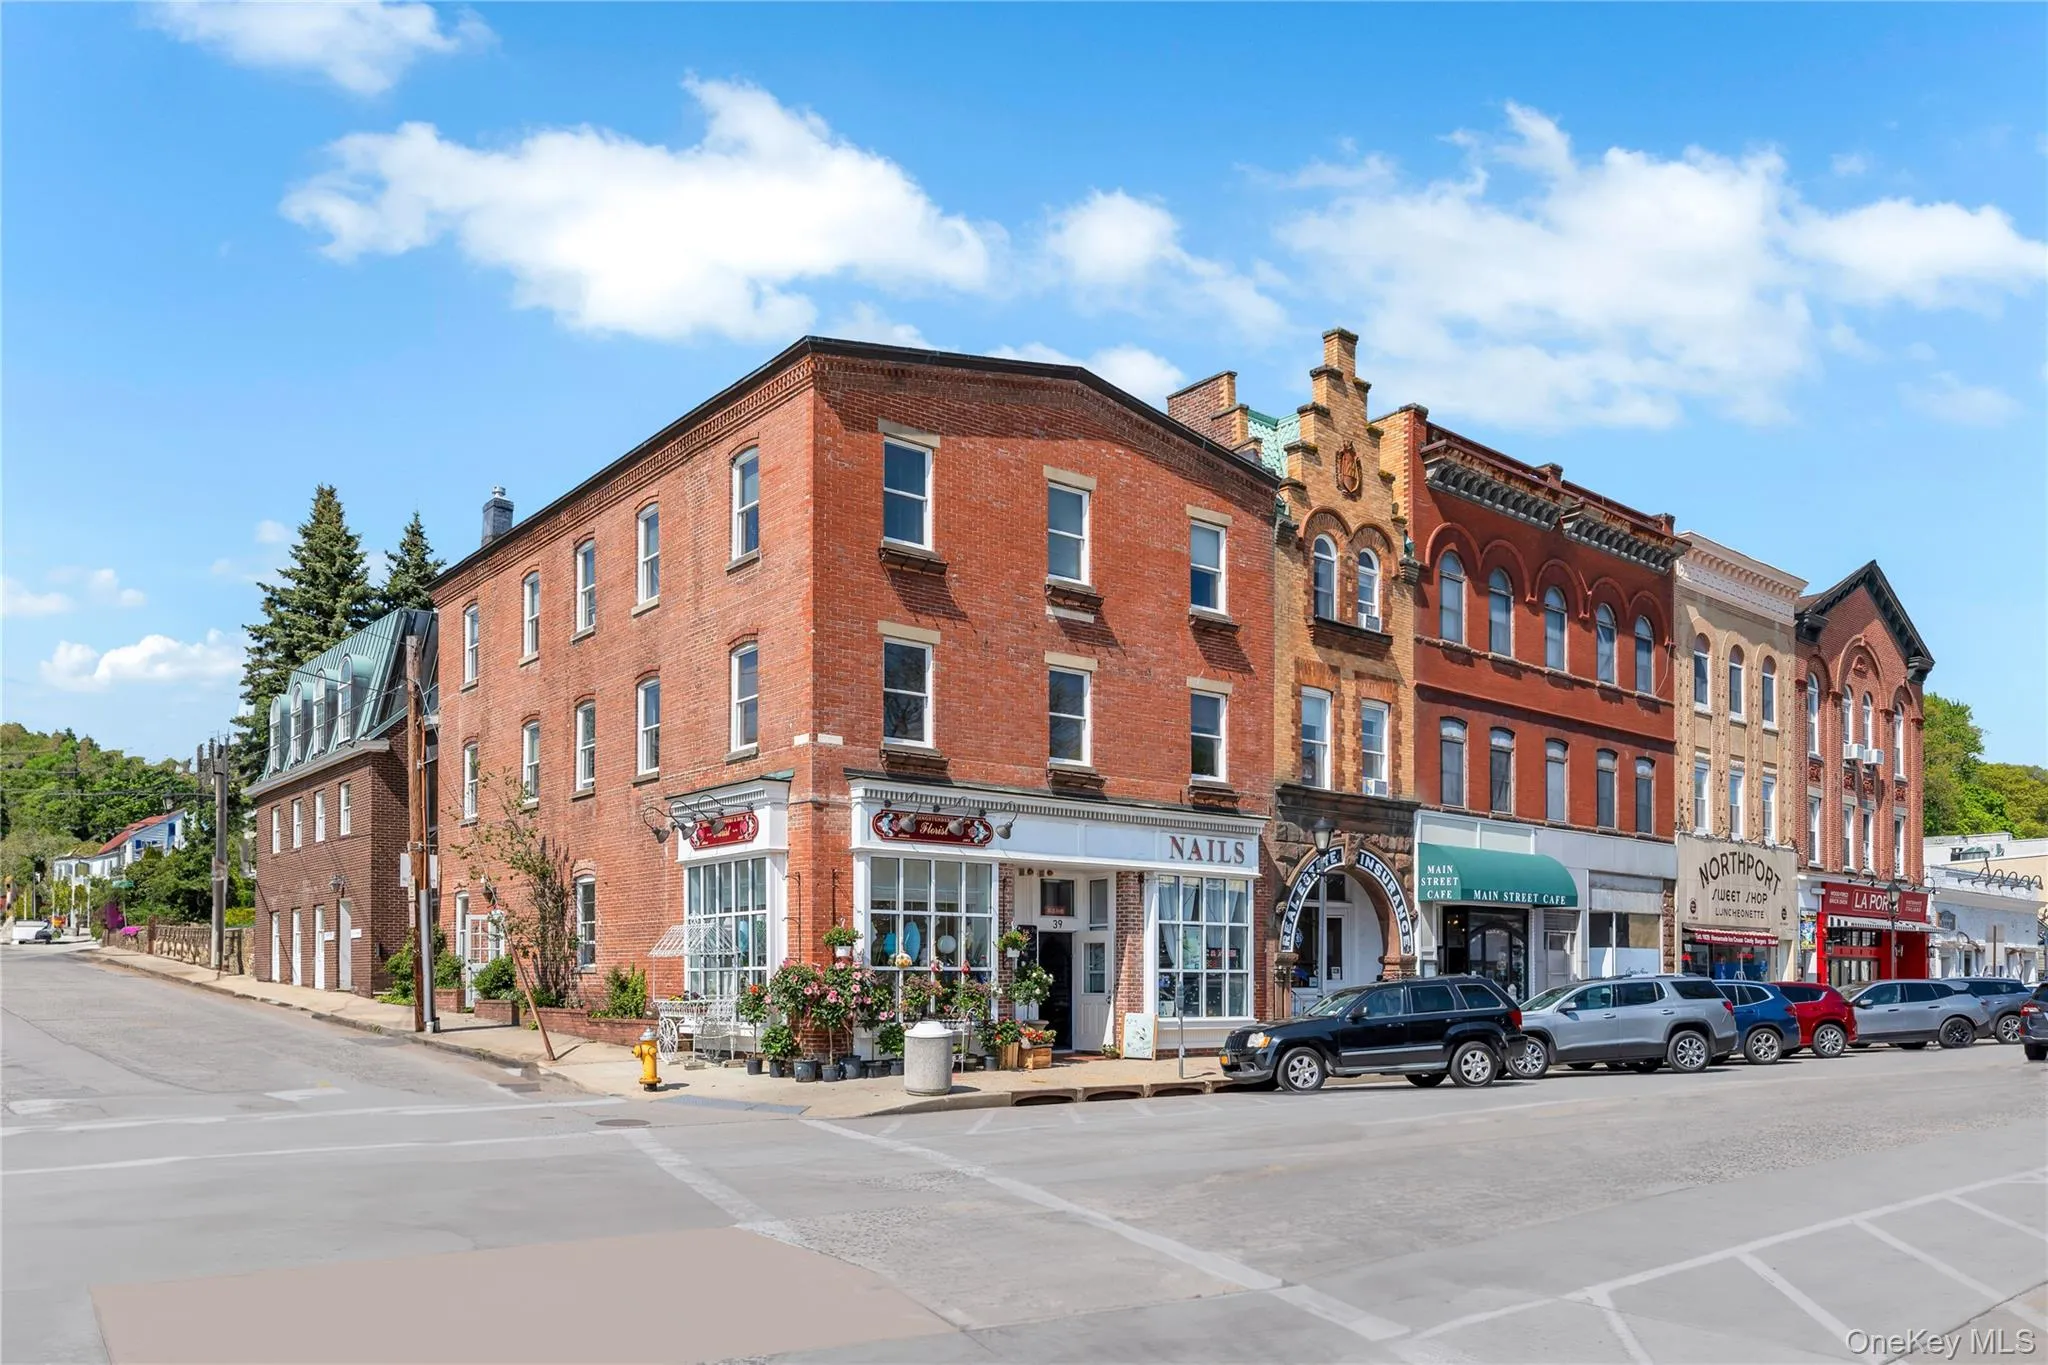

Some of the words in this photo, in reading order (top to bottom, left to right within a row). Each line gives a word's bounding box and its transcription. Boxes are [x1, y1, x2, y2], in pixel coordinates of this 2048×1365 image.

[919, 822, 950, 836] Florist
[1169, 835, 1245, 864] NAILS
[1427, 865, 1453, 874] MAIN
[1699, 851, 1781, 895] NORTHPORT
[1421, 877, 1459, 886] STREET
[1360, 853, 1411, 946] INSURANCE
[1427, 890, 1453, 899] CAFE
[1473, 889, 1499, 901] MAIN
[1503, 891, 1539, 903] STREET
[1543, 893, 1566, 905] CAFE
[1711, 888, 1741, 903] SWEET
[1745, 892, 1768, 905] SHOP
[1854, 892, 1867, 909] LA
[1869, 893, 1899, 912] PORA
[1715, 908, 1765, 919] LUNCHEONETTE
[1052, 919, 1063, 929] 39
[1282, 899, 1300, 947] REAL
